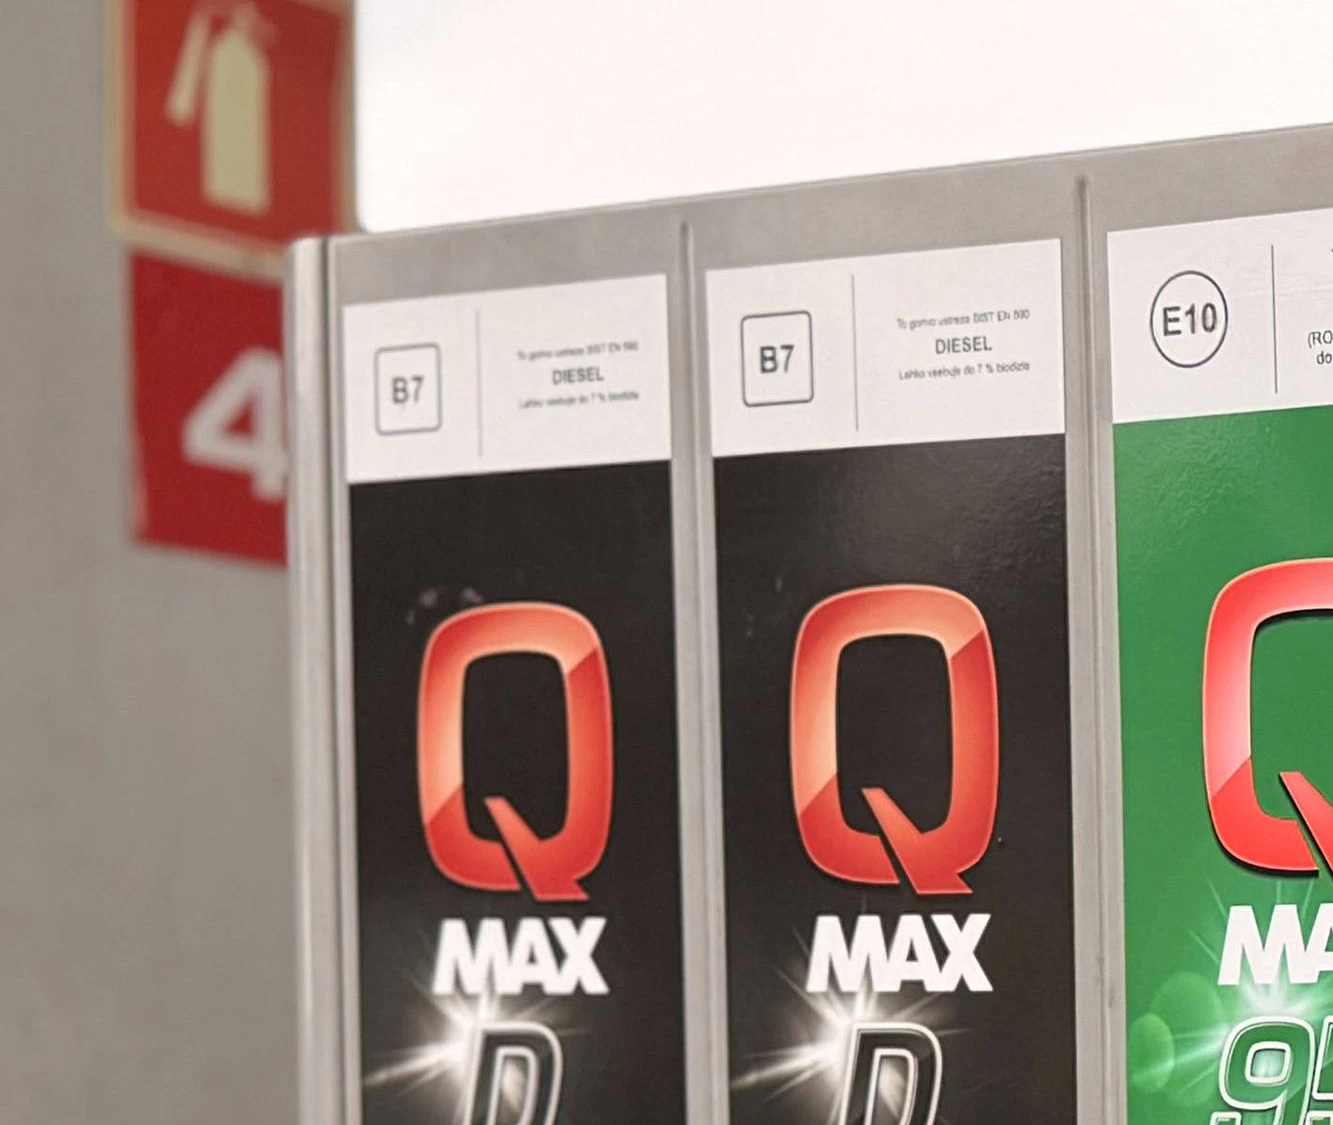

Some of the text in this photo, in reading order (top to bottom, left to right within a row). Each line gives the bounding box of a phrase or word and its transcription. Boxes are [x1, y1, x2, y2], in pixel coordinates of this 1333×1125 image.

[935, 336, 992, 354] DIESEL
[1162, 302, 1217, 337] E10
[552, 366, 604, 385] DIESEL
[759, 345, 795, 374] B7
[392, 376, 425, 405] B7
[182, 350, 288, 500] 4
[417, 602, 613, 900] Q
[790, 584, 999, 895] Q
[431, 917, 609, 995] MAX
[805, 913, 993, 992] MAX
